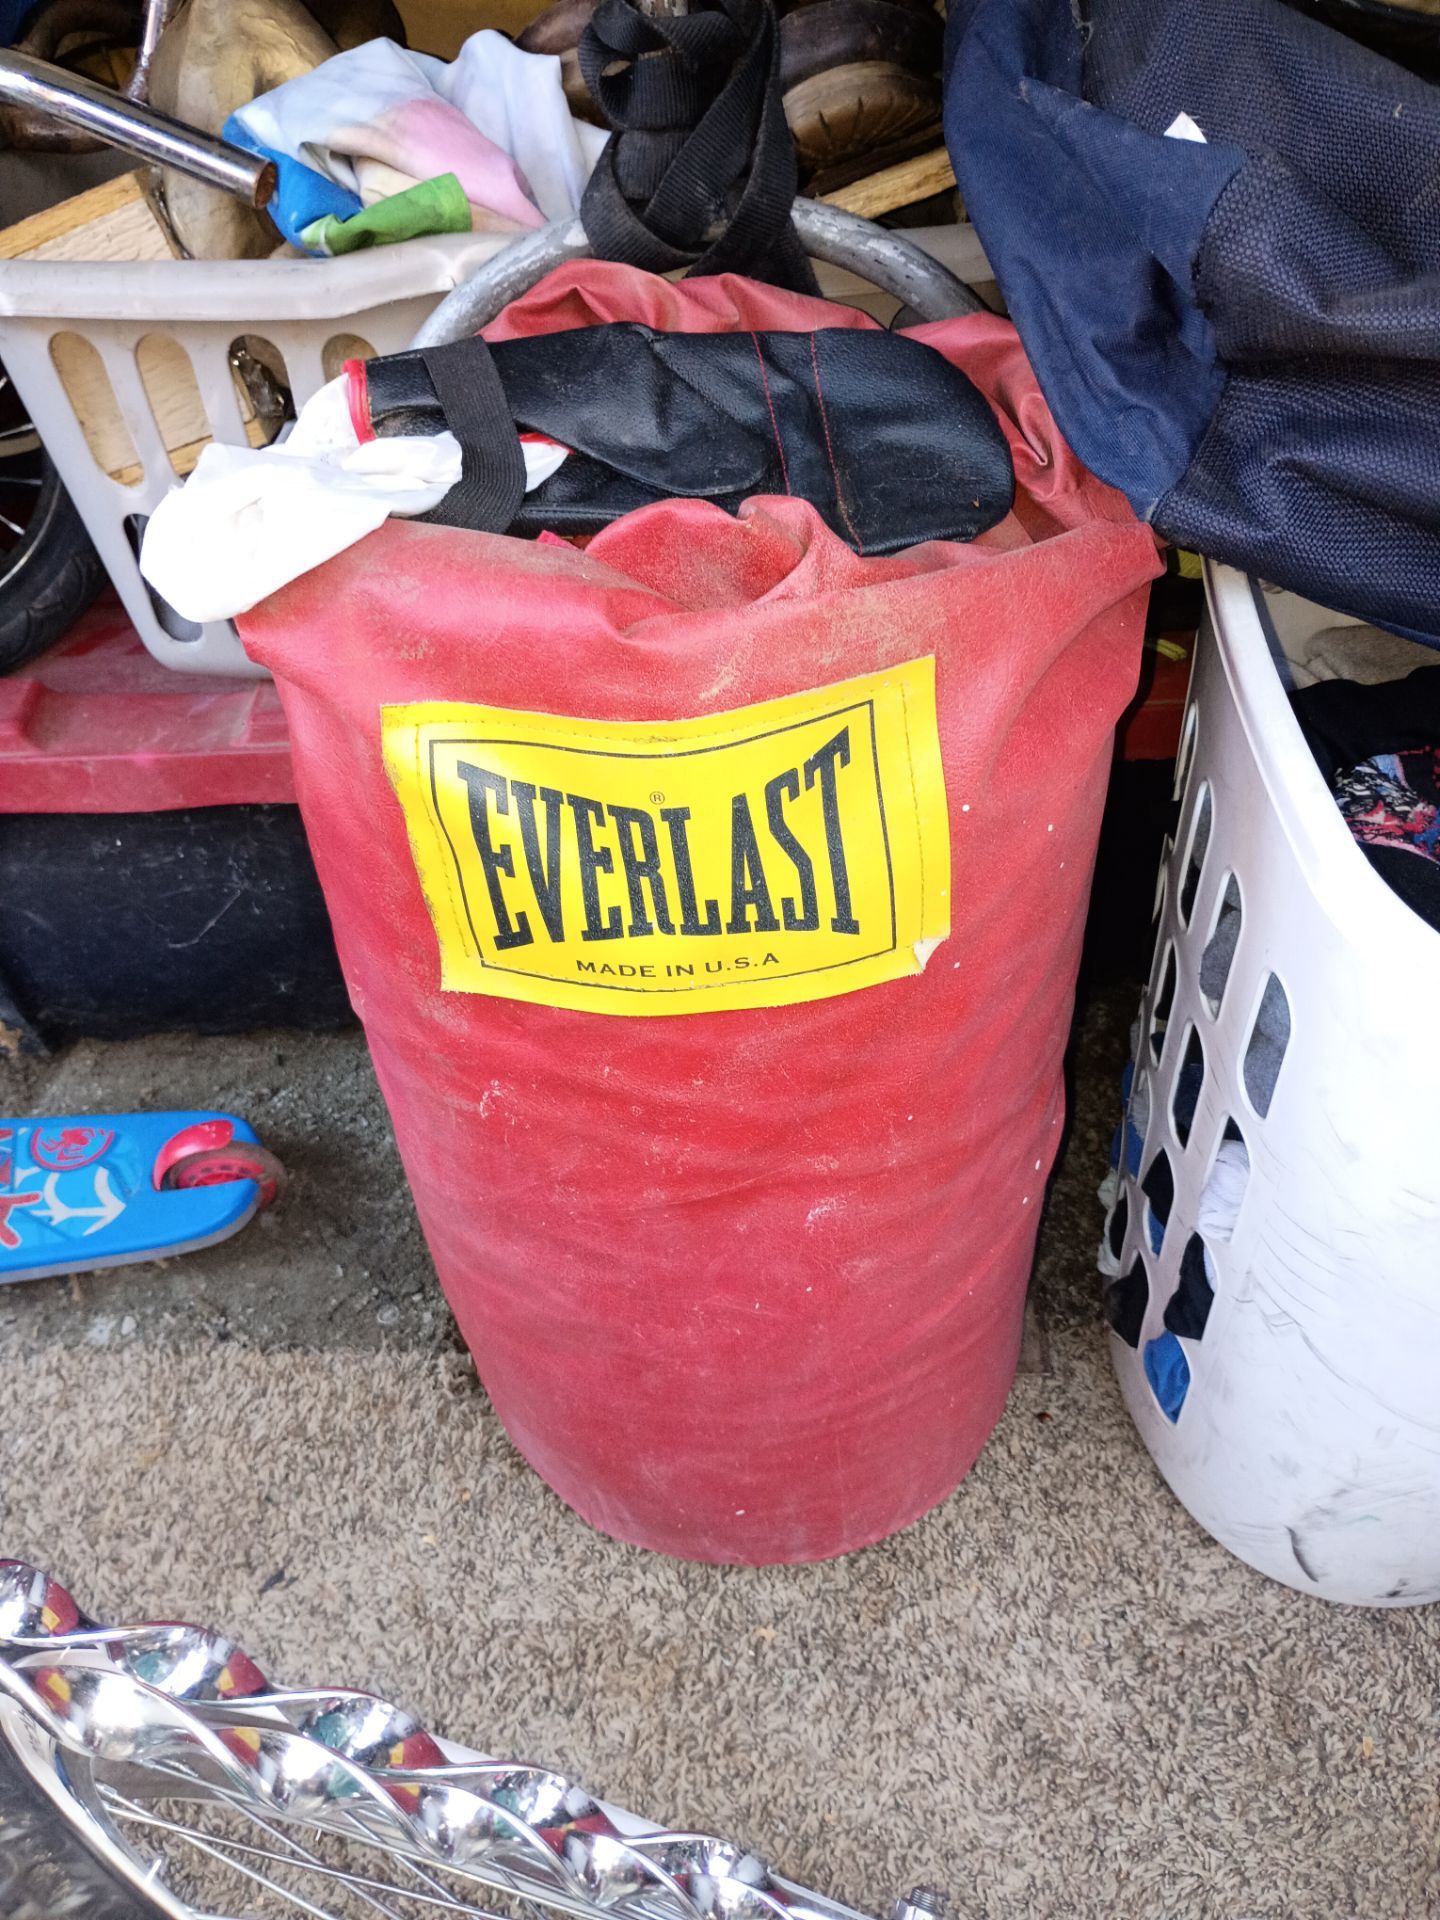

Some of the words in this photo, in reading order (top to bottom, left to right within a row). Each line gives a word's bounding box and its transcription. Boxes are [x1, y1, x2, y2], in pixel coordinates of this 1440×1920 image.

[457, 726, 860, 951] EVERLAST
[576, 960, 656, 977] MADE
[666, 964, 694, 977] IN
[705, 953, 779, 973] U.S.A
